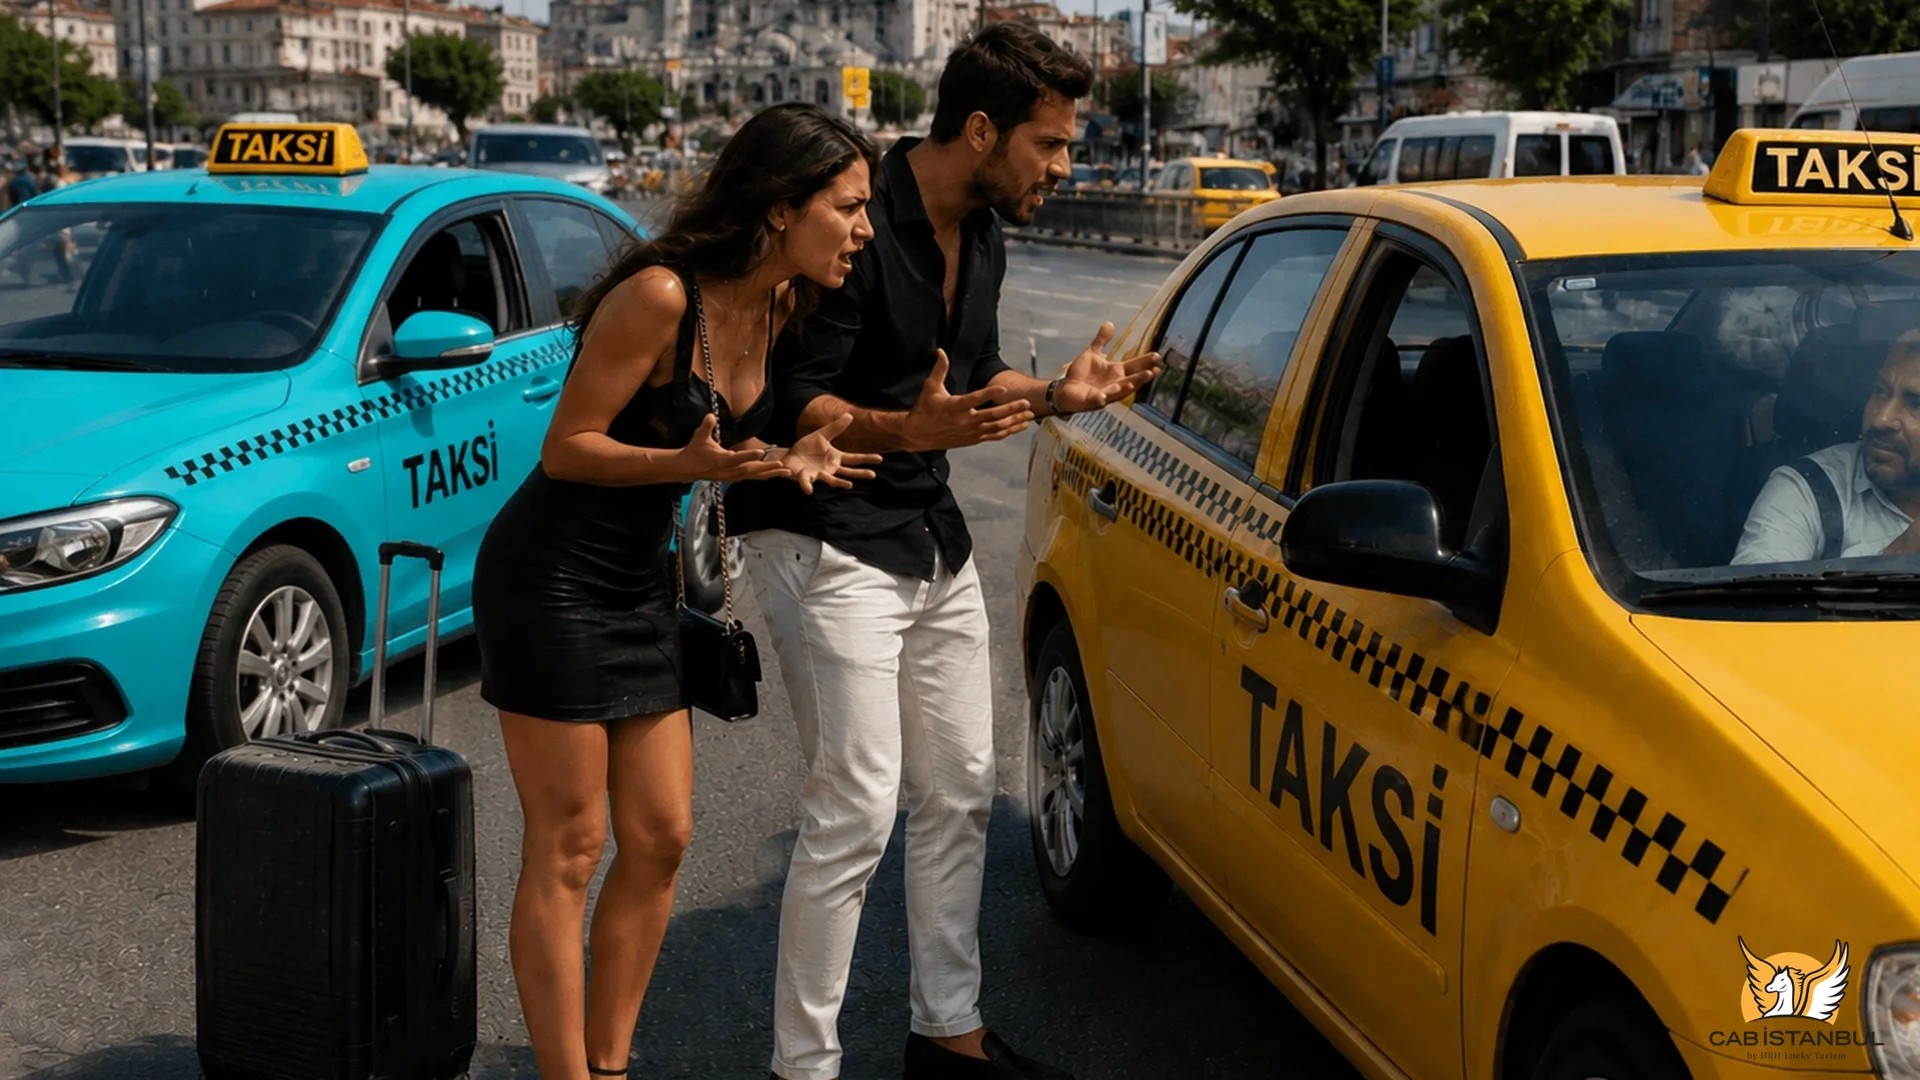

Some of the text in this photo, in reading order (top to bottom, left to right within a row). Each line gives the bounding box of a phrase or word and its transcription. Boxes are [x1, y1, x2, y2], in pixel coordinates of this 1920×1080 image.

[228, 132, 328, 162] TAKSİ
[402, 419, 498, 509] TAKSİ
[1240, 664, 1448, 937] TAKSİ
